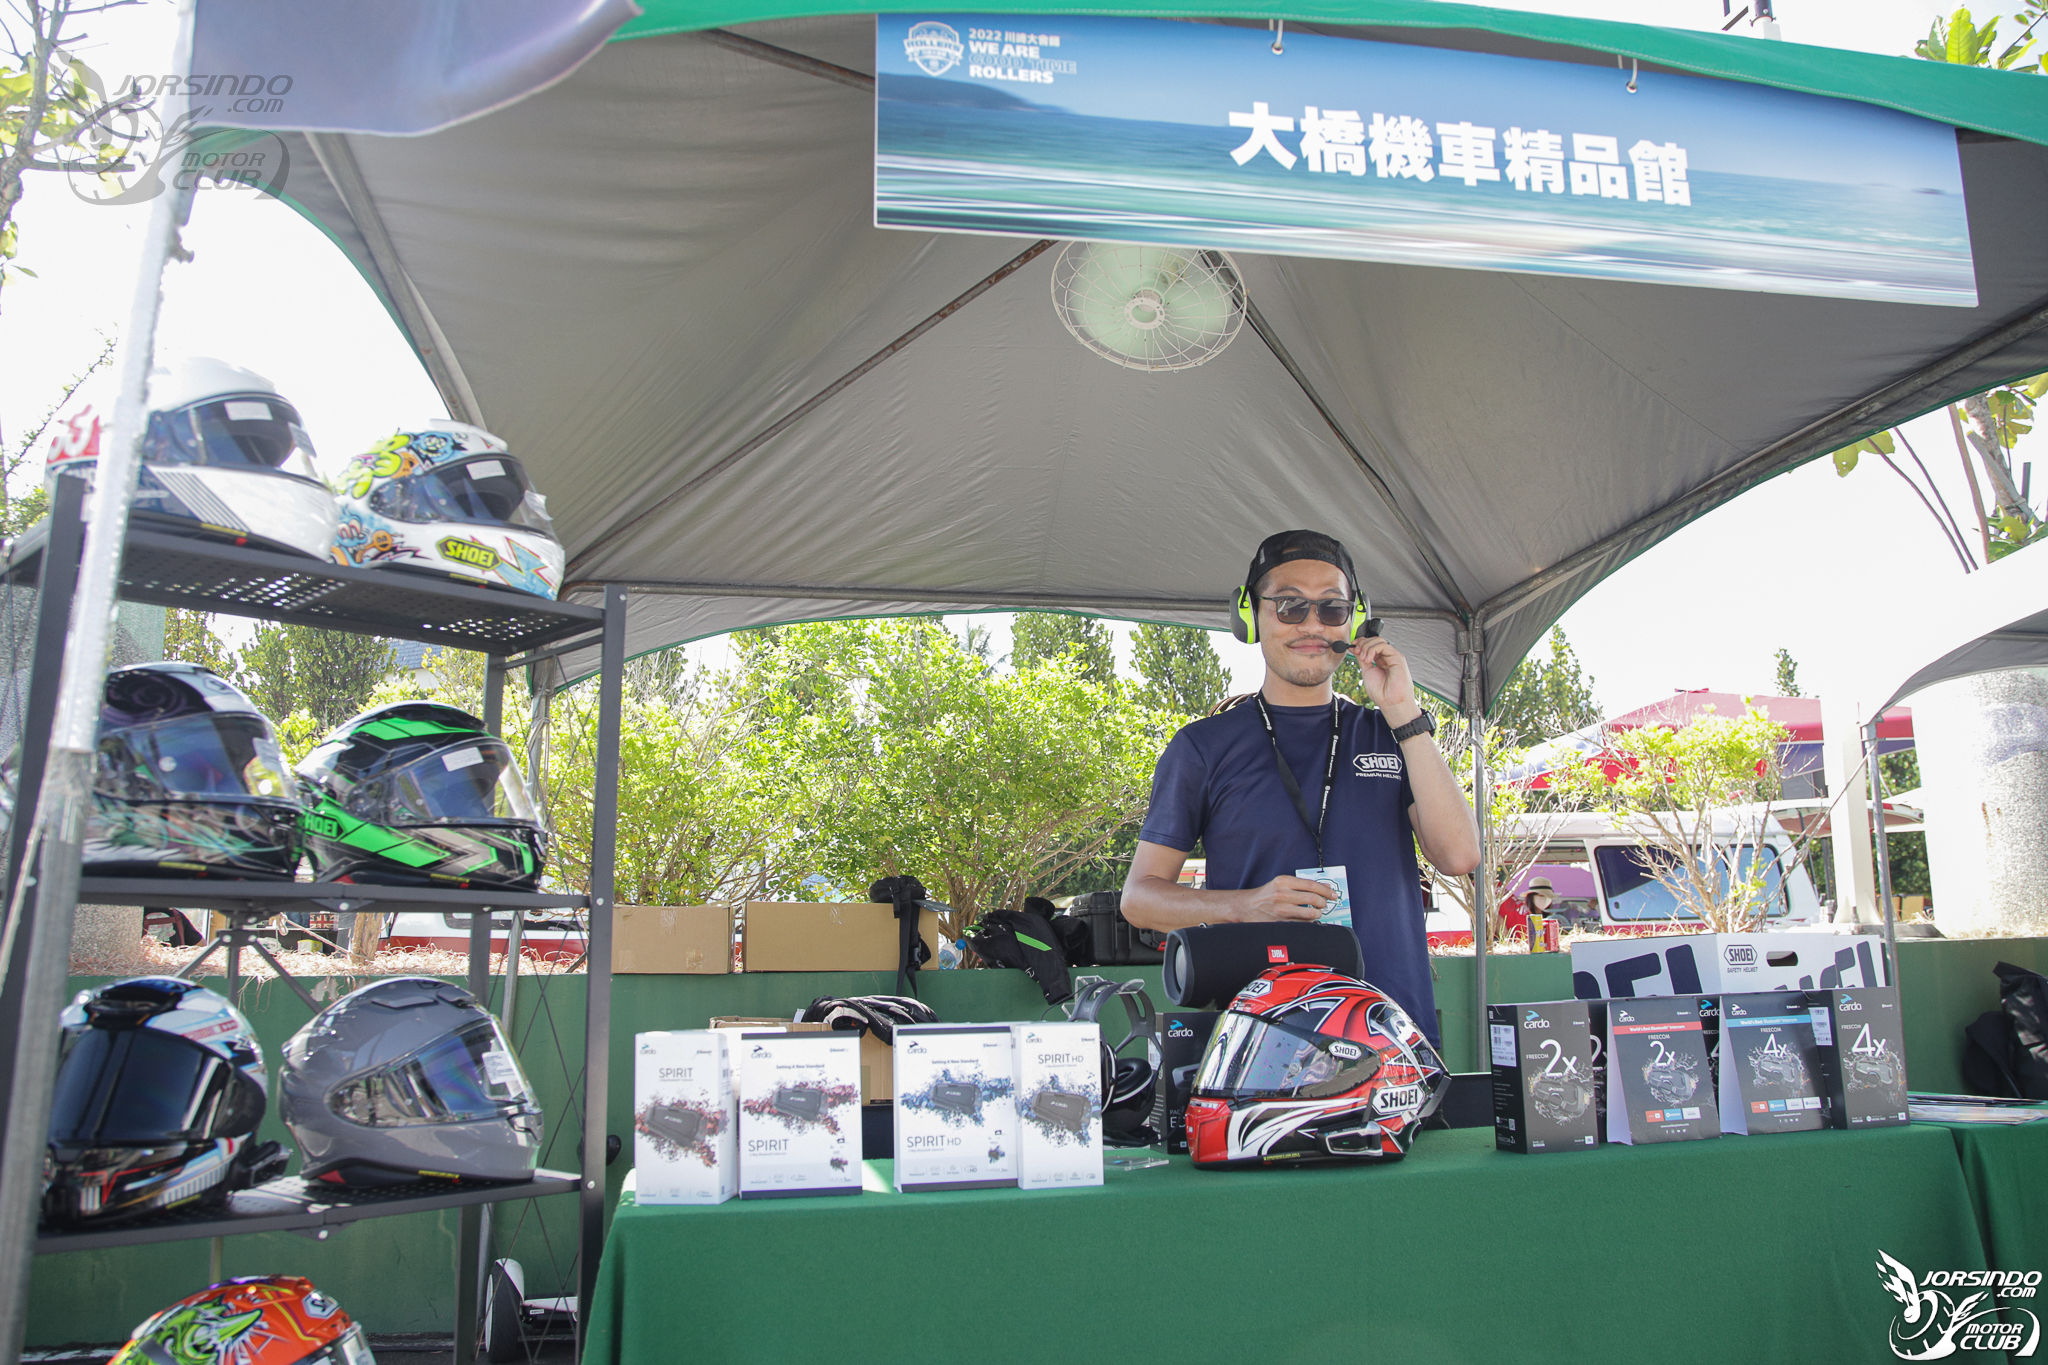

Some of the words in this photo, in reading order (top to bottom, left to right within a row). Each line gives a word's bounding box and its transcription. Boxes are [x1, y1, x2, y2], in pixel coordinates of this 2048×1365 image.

[968, 28, 1002, 41] 2022
[968, 40, 999, 55] WE
[1002, 44, 1040, 59] ARE
[968, 54, 1024, 68] GOOD
[1028, 59, 1077, 74] TIME
[969, 64, 1054, 84] ROLLERS
[1228, 101, 1692, 206] 大橋機車精品館
[445, 540, 494, 567] SHOEI
[1360, 756, 1399, 770] SHOEI
[304, 814, 338, 837] HOEI
[1271, 950, 1285, 958] JBL
[1728, 948, 1754, 962] SHOEI
[1839, 1002, 1862, 1012] cardo
[1524, 1018, 1550, 1029] cardo
[1168, 1028, 1194, 1038] cardo
[1851, 1023, 1886, 1057] 4x
[1334, 1045, 1356, 1056] SHOEI
[1590, 1034, 1608, 1070] 2
[1650, 1040, 1676, 1066] 2x
[1764, 1034, 1787, 1058] 4x
[1038, 1054, 1070, 1064] SPIRIT
[1539, 1039, 1578, 1077] 2x
[659, 1068, 694, 1078] SPIRIT
[1380, 1089, 1418, 1109] SHOEI
[748, 1140, 789, 1152] SPIRIT
[906, 1136, 945, 1148] SPIRIT
[947, 1138, 962, 1146] HD
